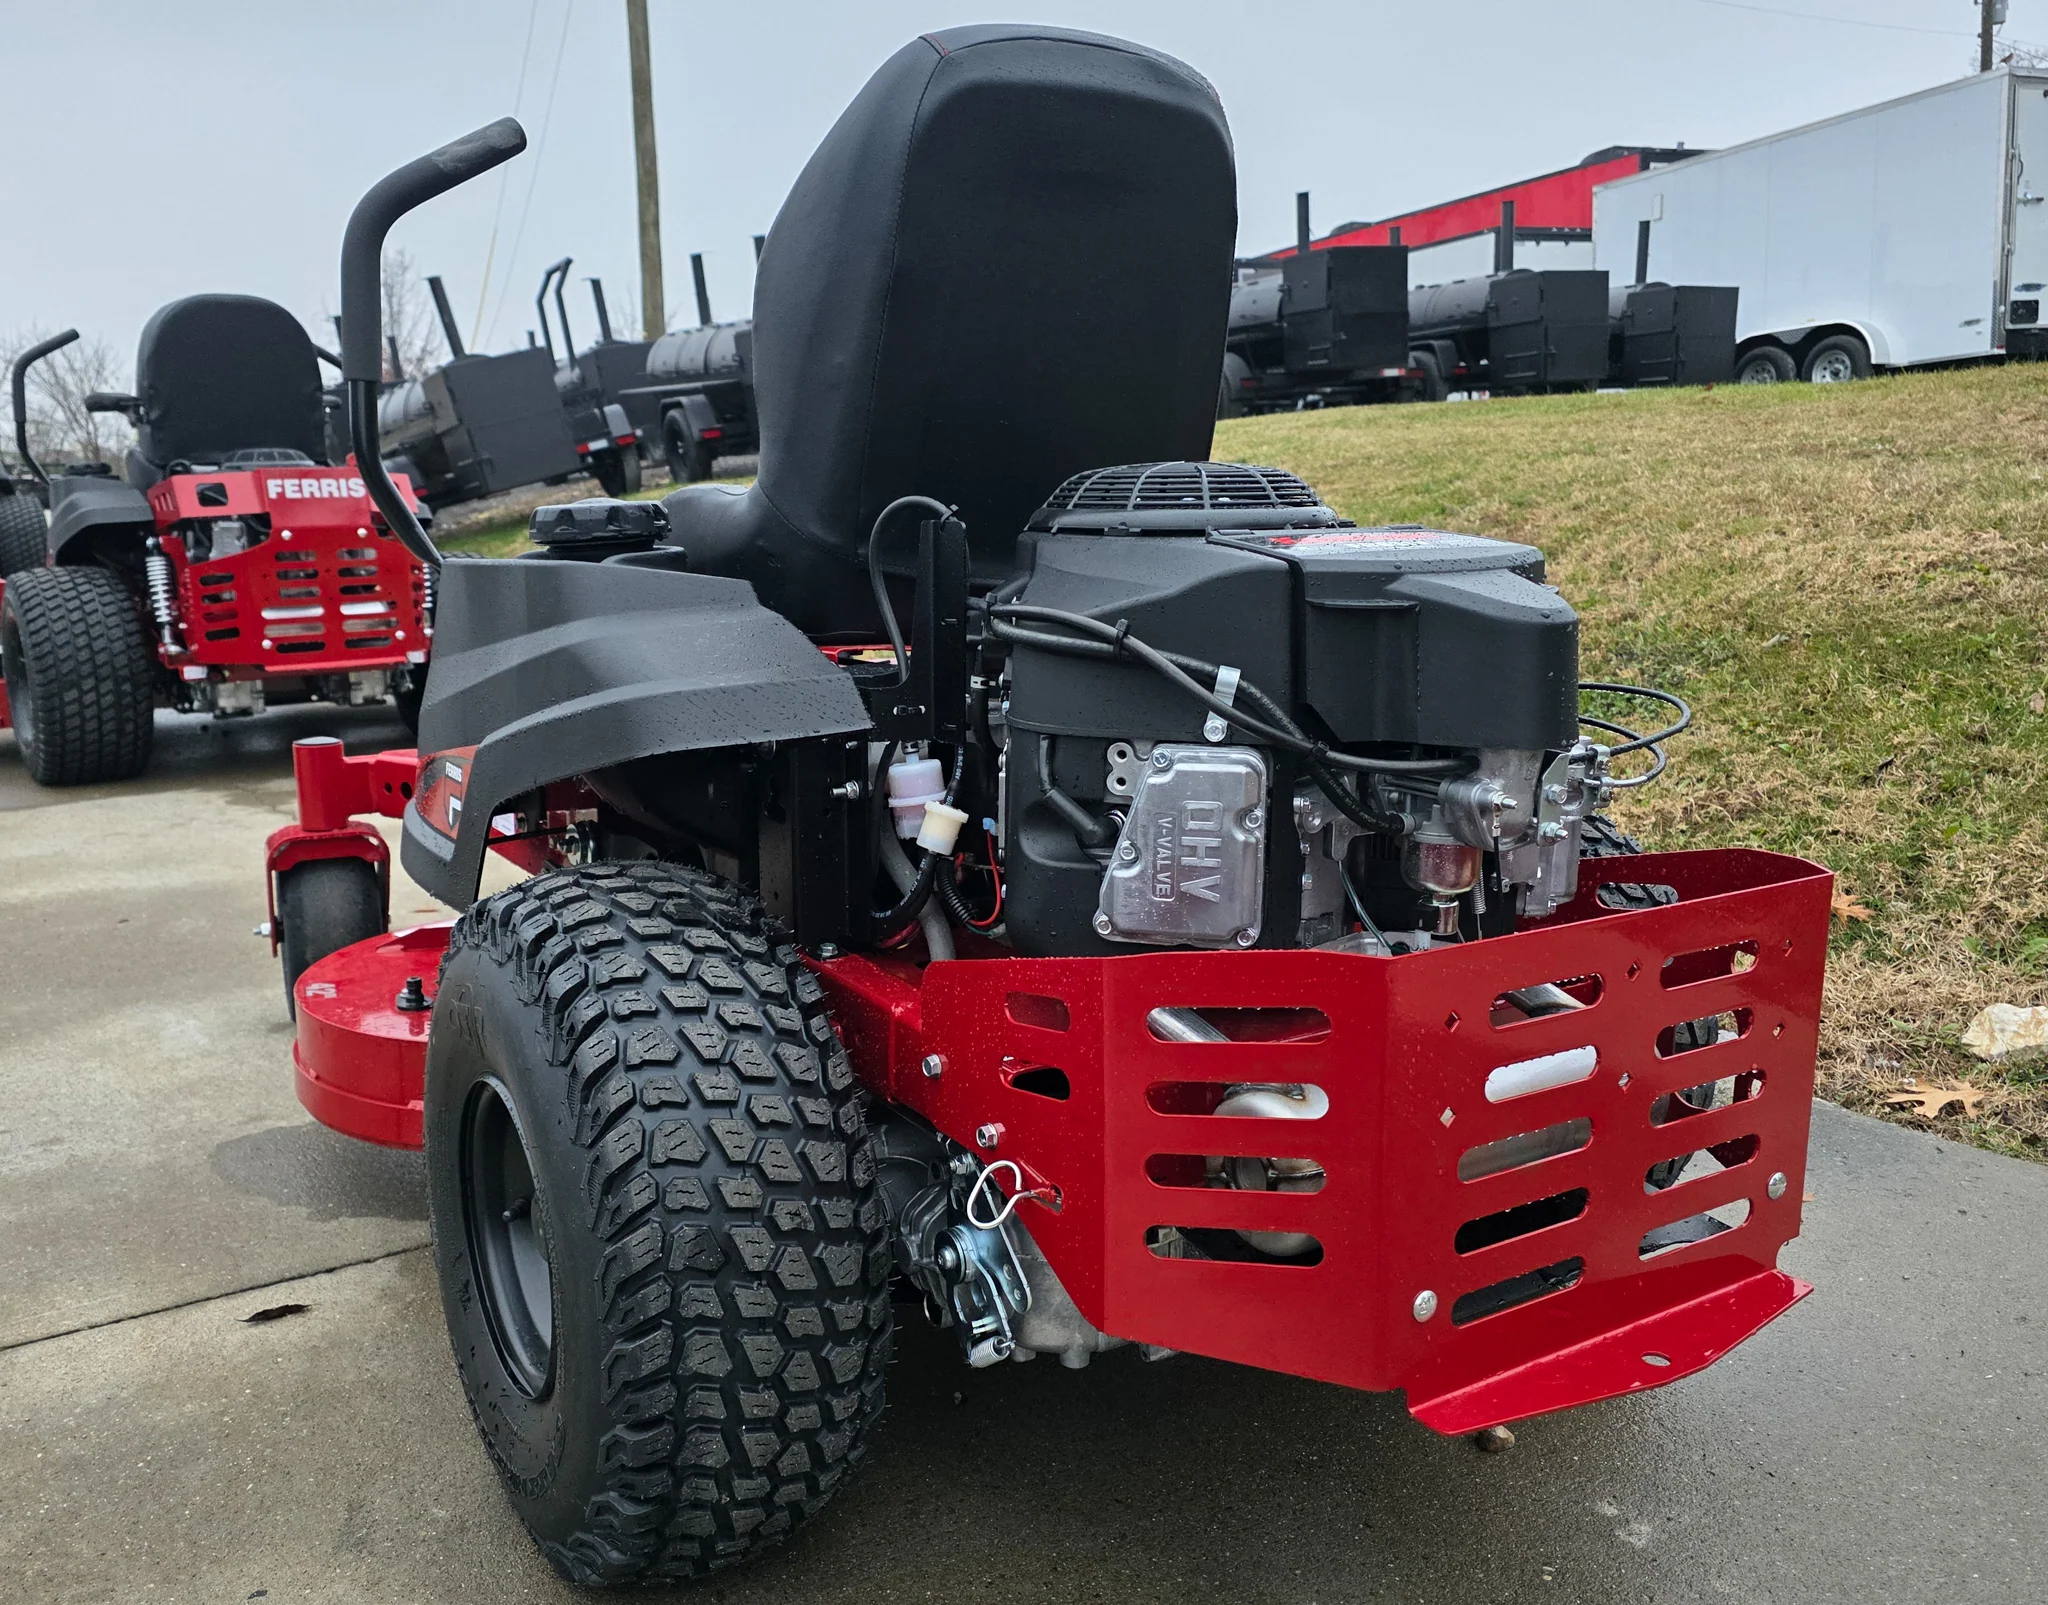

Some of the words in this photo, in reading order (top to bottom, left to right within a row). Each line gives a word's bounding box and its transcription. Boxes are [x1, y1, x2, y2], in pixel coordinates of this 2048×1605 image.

[266, 478, 366, 499] FERRIS
[1156, 818, 1173, 897] V-VALVE
[1180, 801, 1223, 904] OHV
